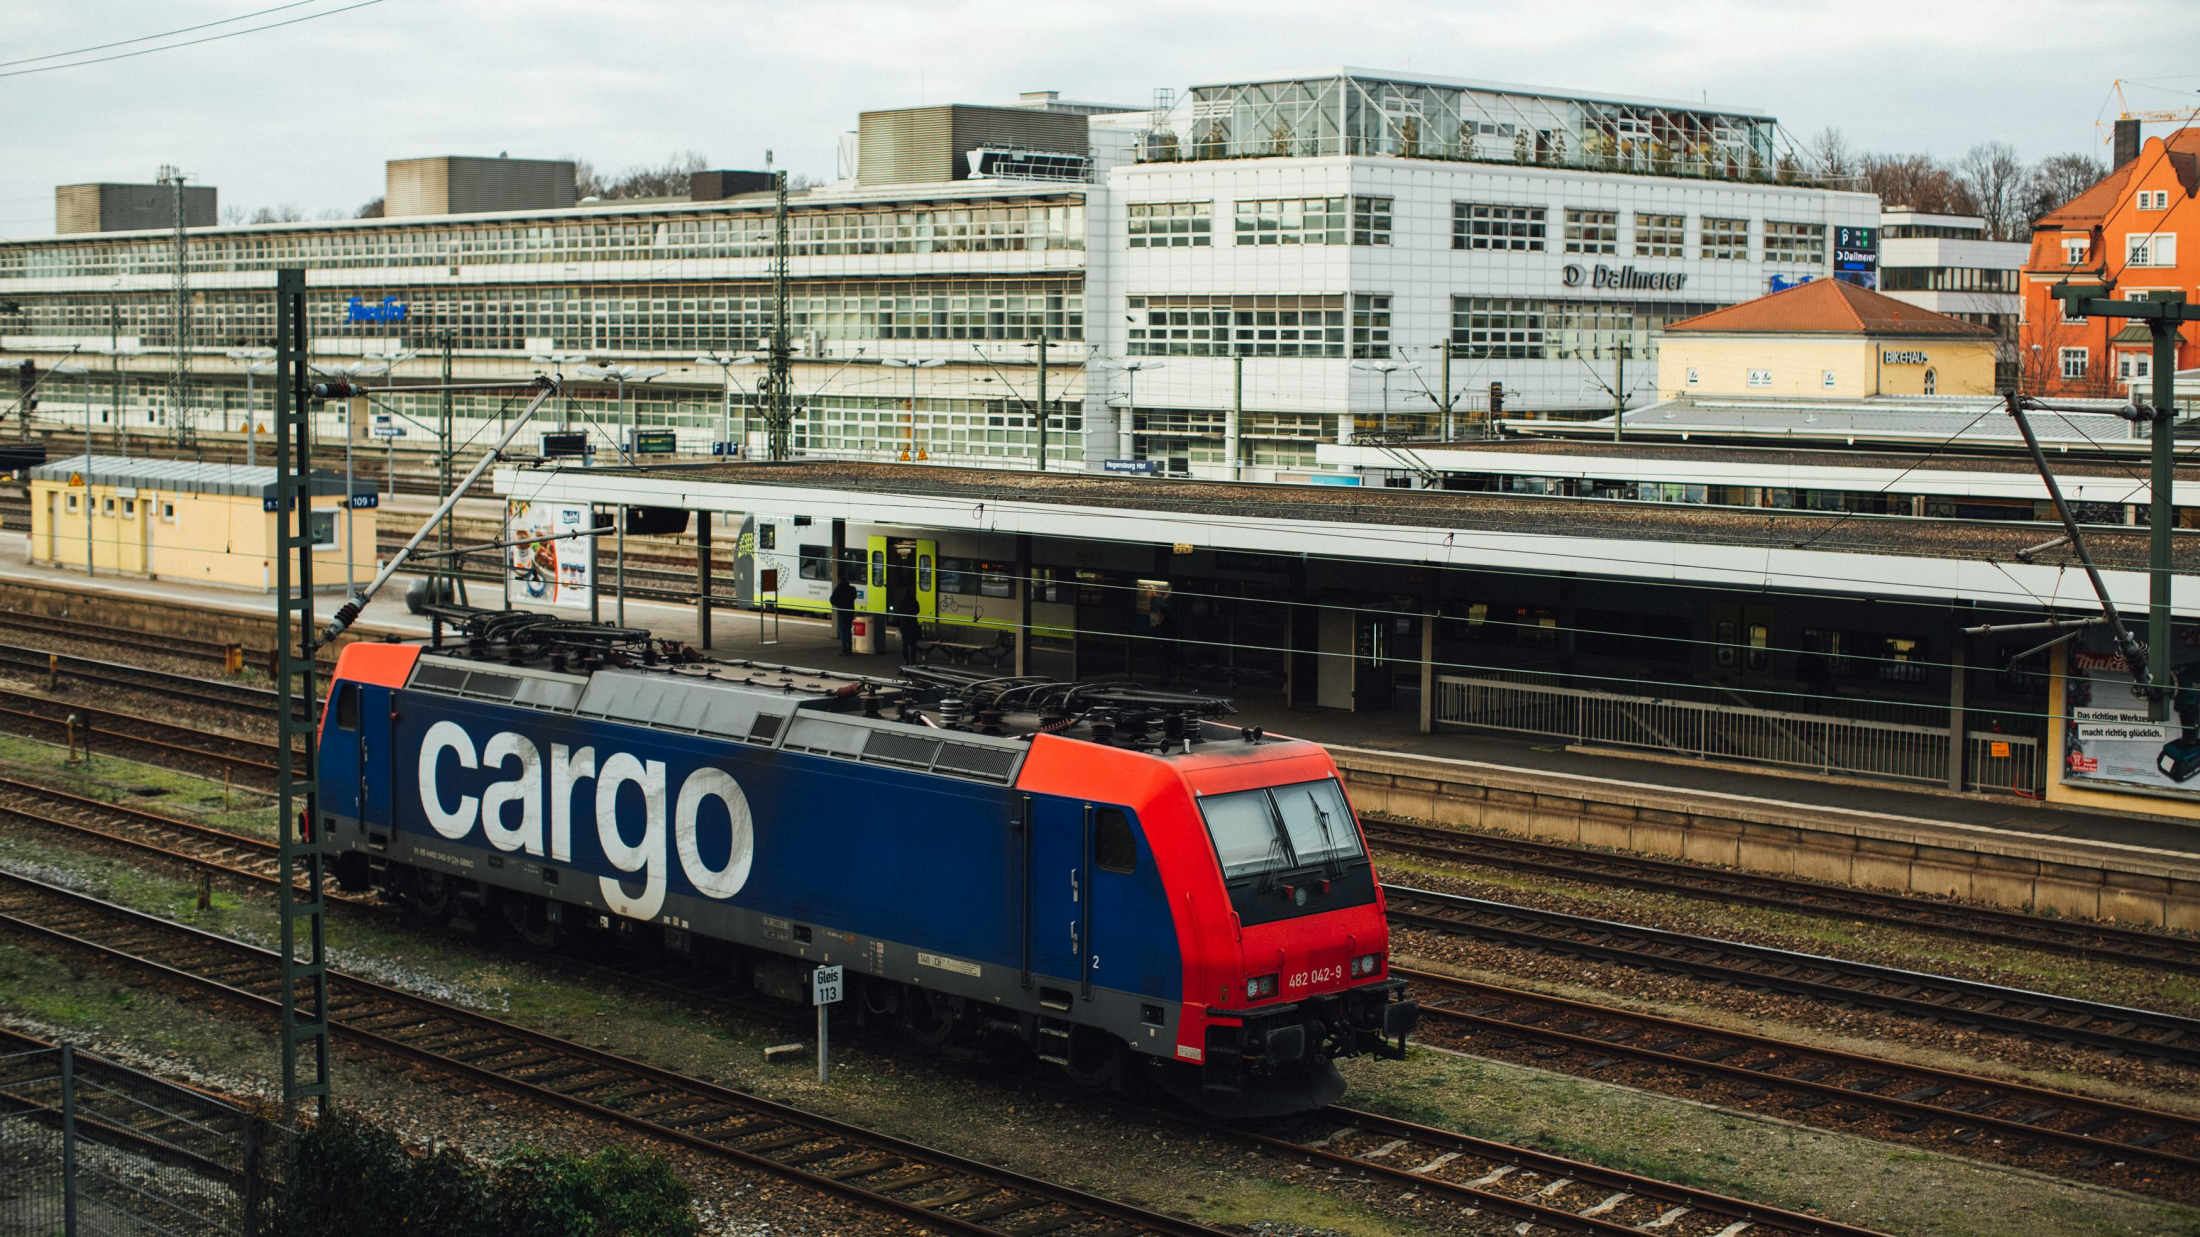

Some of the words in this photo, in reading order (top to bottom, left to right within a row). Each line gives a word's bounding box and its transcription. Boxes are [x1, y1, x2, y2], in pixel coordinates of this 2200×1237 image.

[1844, 251, 1876, 262] Dallmeier
[1593, 264, 1688, 290] Dallmeier
[1884, 351, 1929, 364] BIKEHAUS
[1106, 461, 1136, 471] Regensburg
[353, 496, 368, 507] 109
[1076, 548, 1103, 566] agilis
[2077, 711, 2091, 719] Das
[2092, 712, 2118, 722] richtige
[2082, 728, 2104, 737] macht
[2105, 728, 2127, 738] richtig
[2128, 729, 2162, 738] glücklich.
[418, 719, 754, 921] cargo
[1092, 955, 1099, 969] 2
[817, 969, 838, 985] Gleis
[1288, 974, 1308, 988] 482
[1311, 965, 1342, 984] 042-9
[819, 986, 837, 1002] 113
